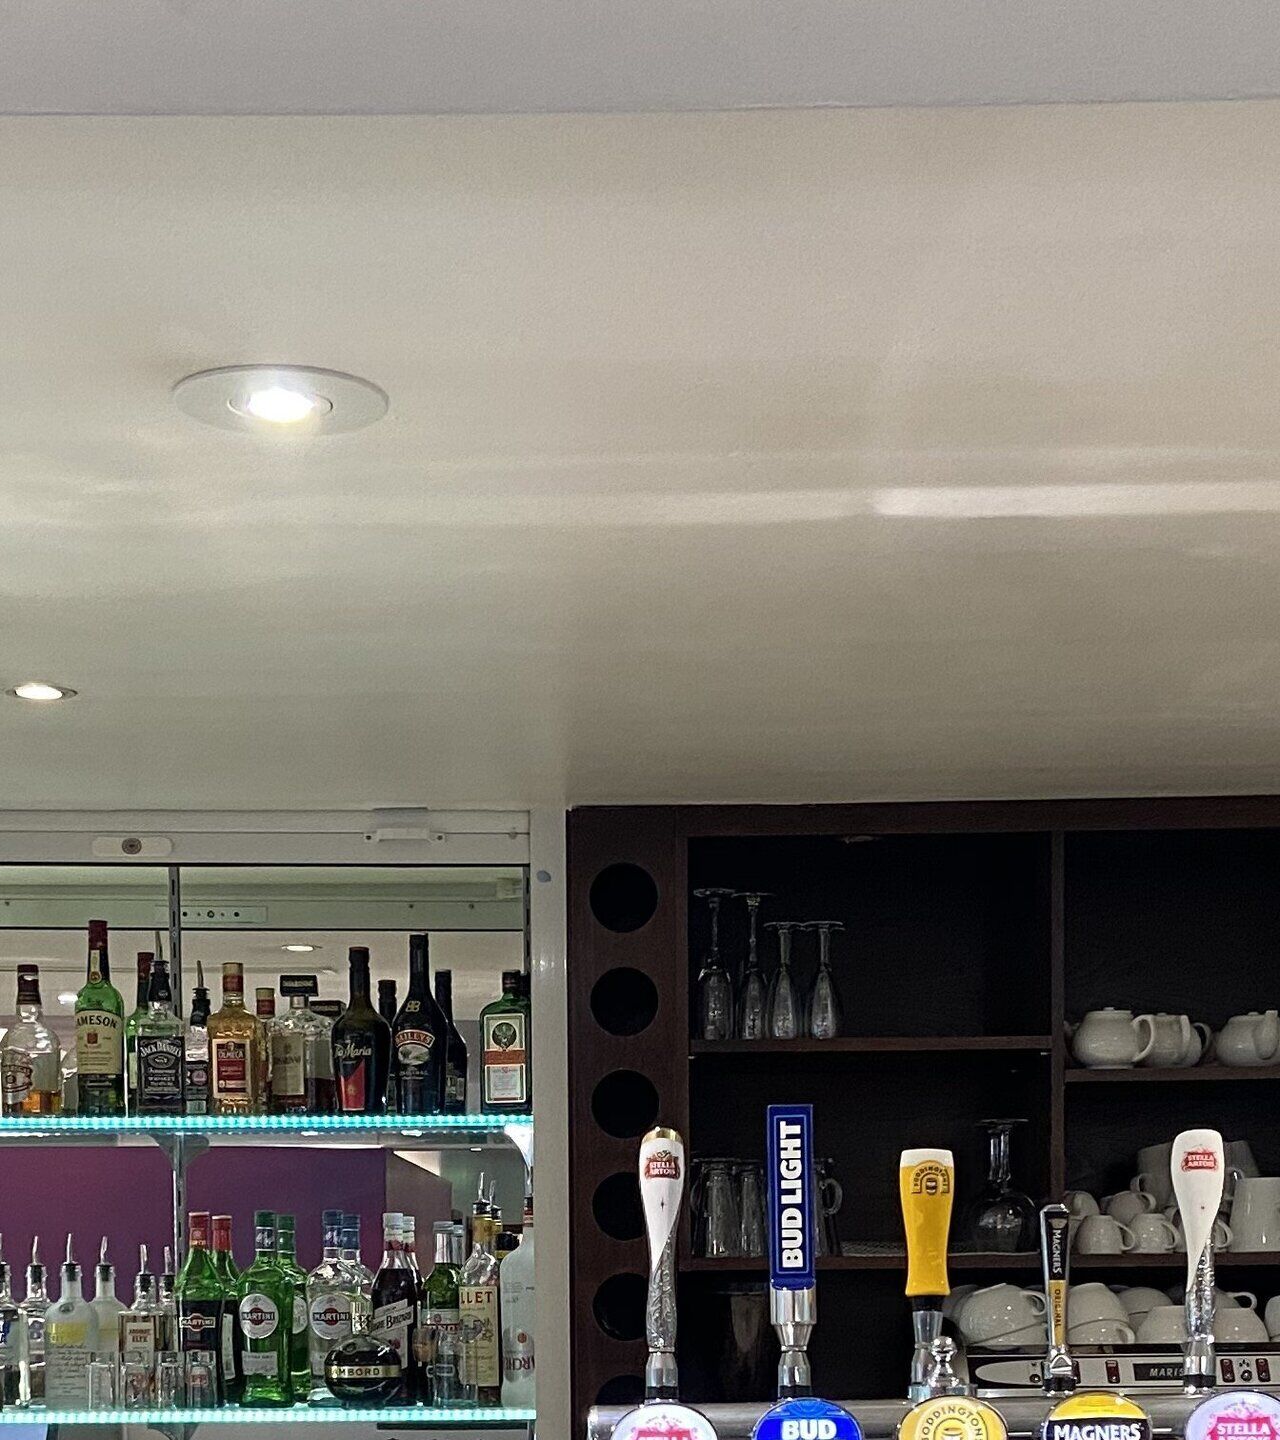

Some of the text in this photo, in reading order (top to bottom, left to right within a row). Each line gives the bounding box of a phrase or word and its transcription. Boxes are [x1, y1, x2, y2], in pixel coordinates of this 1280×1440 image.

[76, 1014, 118, 1029] MESON
[139, 1043, 157, 1058] JACK
[780, 1120, 805, 1269] BUD LIGHT
[1052, 1229, 1063, 1274] MAGNERS
[459, 1291, 493, 1304] LLET
[242, 1312, 276, 1321] MARTINI
[313, 1311, 350, 1321] MARTINI
[1149, 1367, 1185, 1377] MARIS
[1216, 1423, 1271, 1435] STELLA
